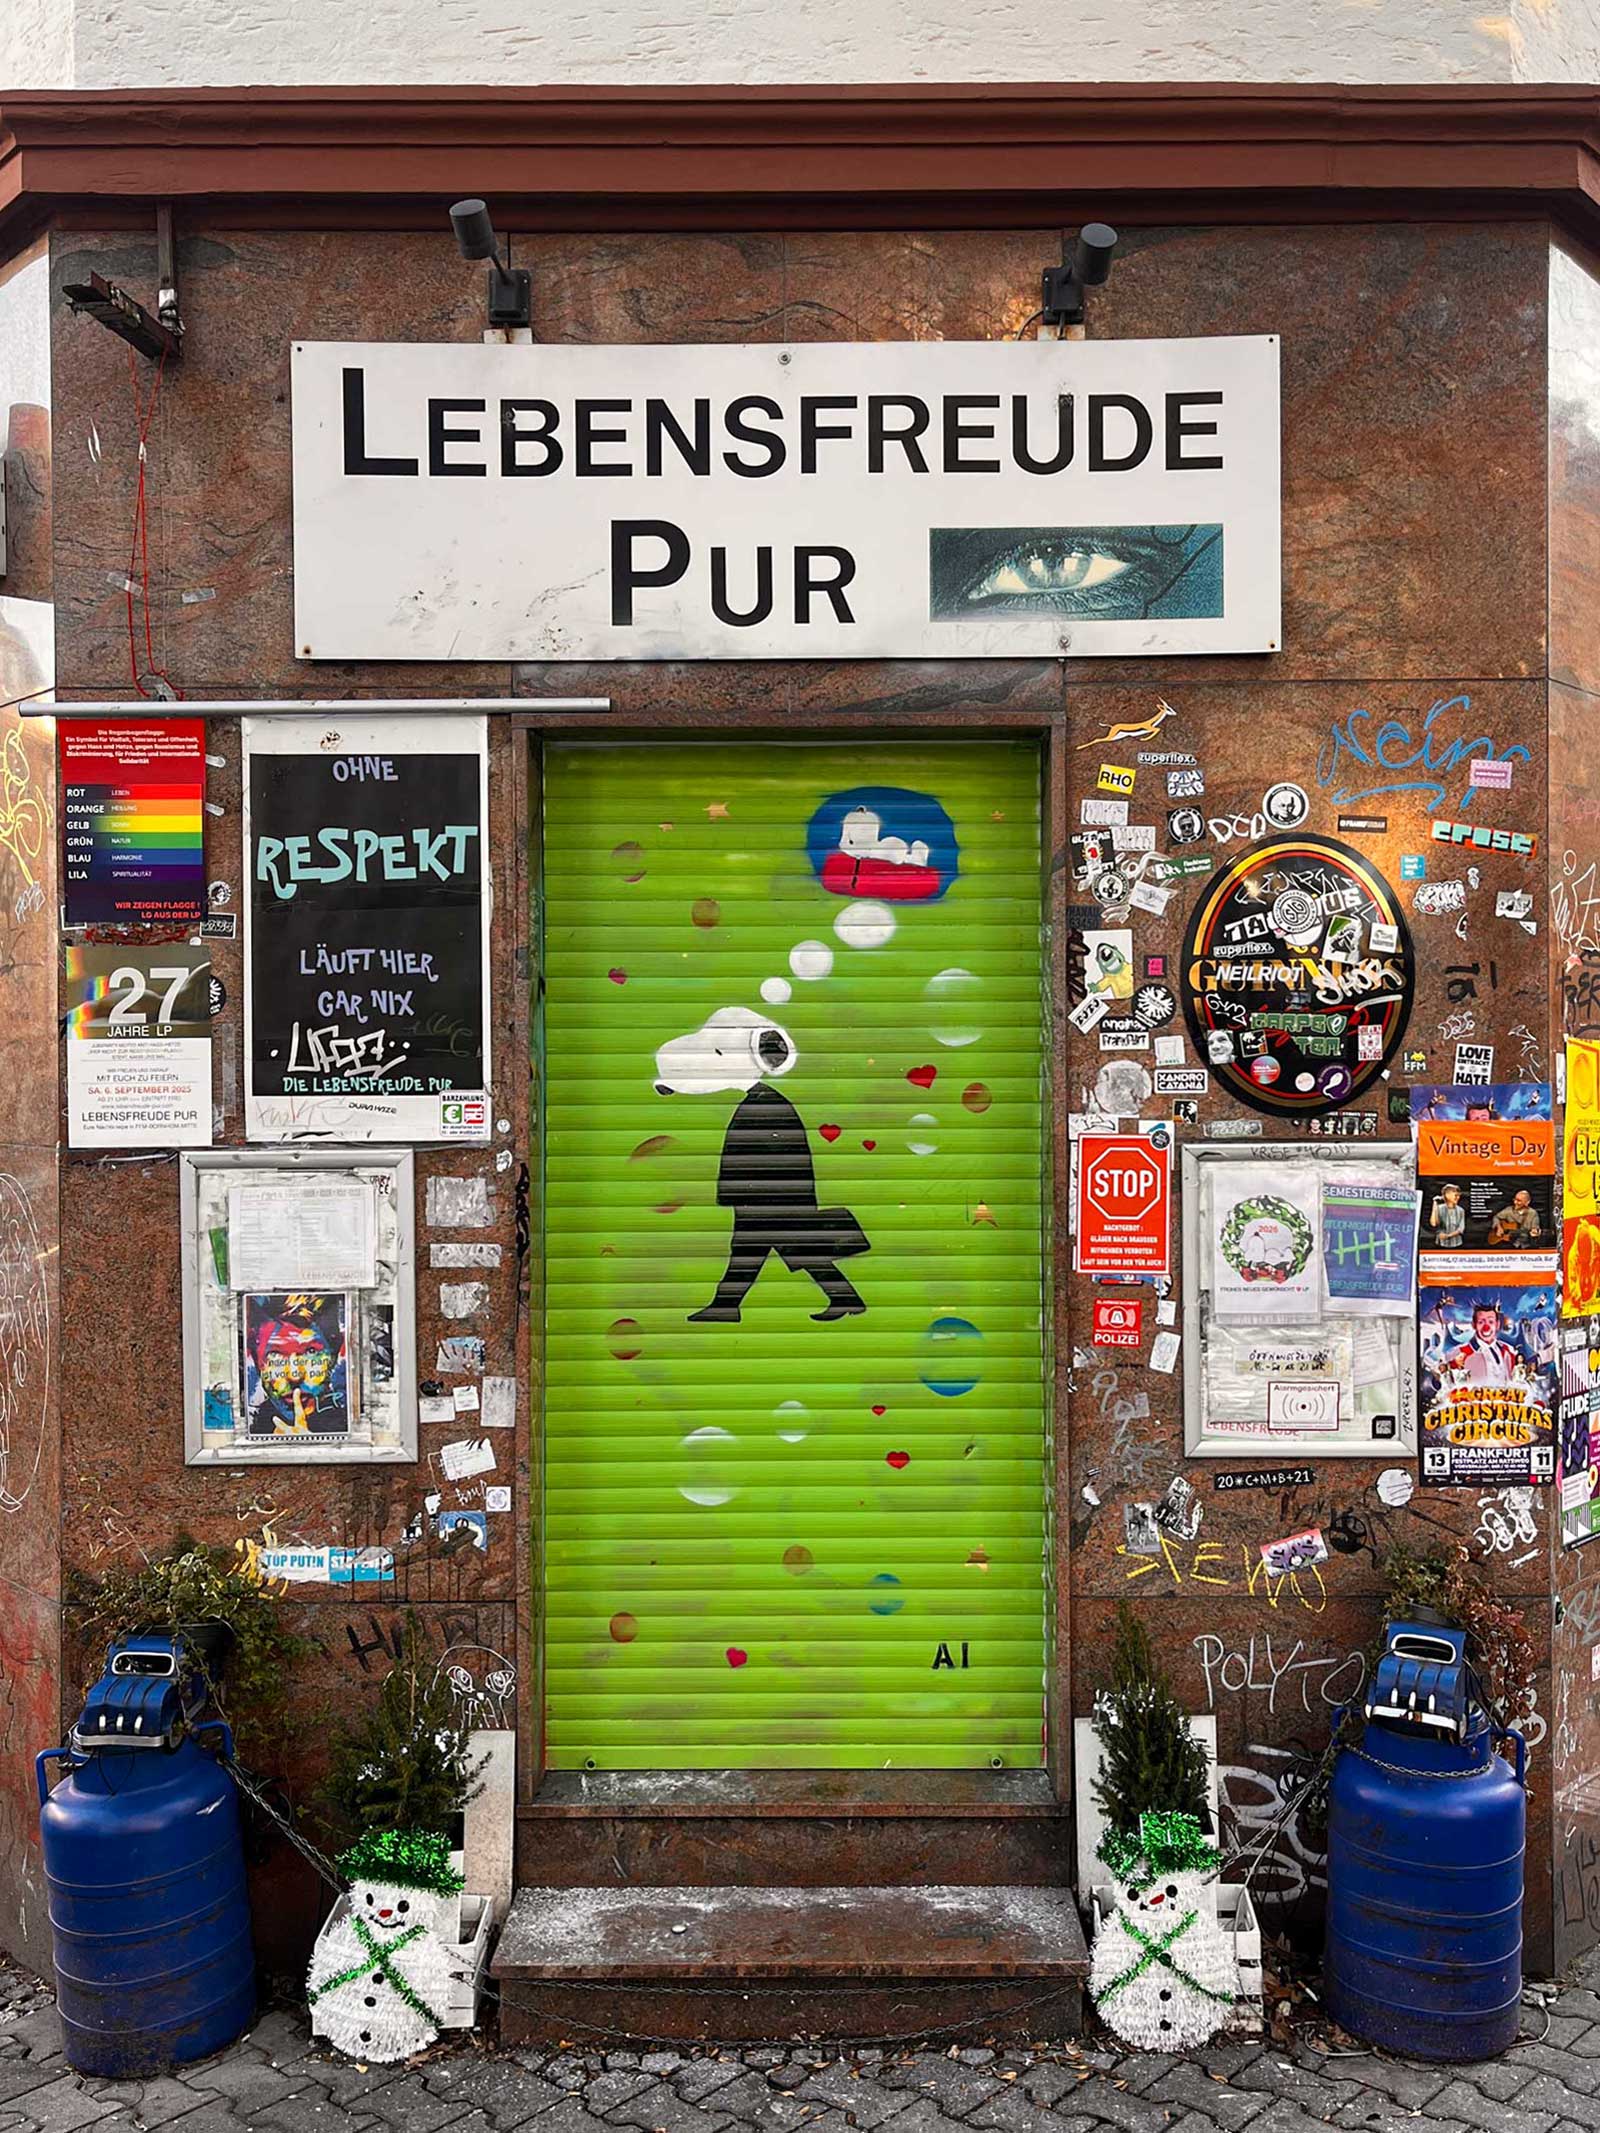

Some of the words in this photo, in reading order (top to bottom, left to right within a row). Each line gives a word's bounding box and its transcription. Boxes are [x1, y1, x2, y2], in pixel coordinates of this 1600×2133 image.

[341, 366, 1225, 477] LEBENSFREUDE
[610, 519, 857, 627] PUR
[333, 756, 398, 782] OHNE
[1100, 771, 1132, 787] RHO
[66, 789, 85, 797] ROT
[66, 805, 105, 814] ORANGE
[66, 821, 90, 830] GELB
[66, 836, 93, 847] GRÜN
[67, 854, 92, 863] BLAU
[257, 825, 478, 899] RESPEKT
[68, 871, 88, 880] LILA
[163, 901, 195, 909] FLAGGE
[154, 911, 171, 919] AUS
[172, 911, 189, 919] DER
[190, 911, 201, 919] LP
[300, 944, 375, 975] LÄUFT
[380, 949, 439, 982] HIER
[1215, 965, 1305, 982] NEILRIOT
[108, 967, 190, 1024] 27
[318, 991, 368, 1024] GAR
[371, 990, 415, 1017] NIX
[107, 1026, 149, 1037] JAHRE
[156, 1026, 172, 1036] LP
[1458, 1046, 1491, 1060] LOVE
[1404, 1061, 1426, 1071] FFM
[1158, 1073, 1204, 1082] XANDRO
[1454, 1072, 1489, 1085] HATE
[115, 1086, 169, 1094] SEPTEMBER
[283, 1077, 309, 1092] DIE
[313, 1076, 425, 1096] LEBENSFREUDE
[429, 1077, 453, 1092] PUR
[1158, 1081, 1204, 1090] CATANIA
[82, 1111, 170, 1122] LEBENSFREUDE
[174, 1111, 198, 1120] PUR
[1429, 1135, 1501, 1158] Vintage
[1511, 1135, 1547, 1158] Day
[1094, 1169, 1154, 1198] STOP
[1094, 1333, 1139, 1345] POLIZEI
[1273, 1384, 1335, 1393] Alarmgesichert
[1469, 1387, 1528, 1403] GREAT
[1424, 1402, 1553, 1431] CHRISTMAS
[1450, 1420, 1531, 1443] CIRCUS
[1451, 1448, 1530, 1459] FRANKFURT
[1536, 1453, 1550, 1466] 11
[1429, 1454, 1446, 1467] 13
